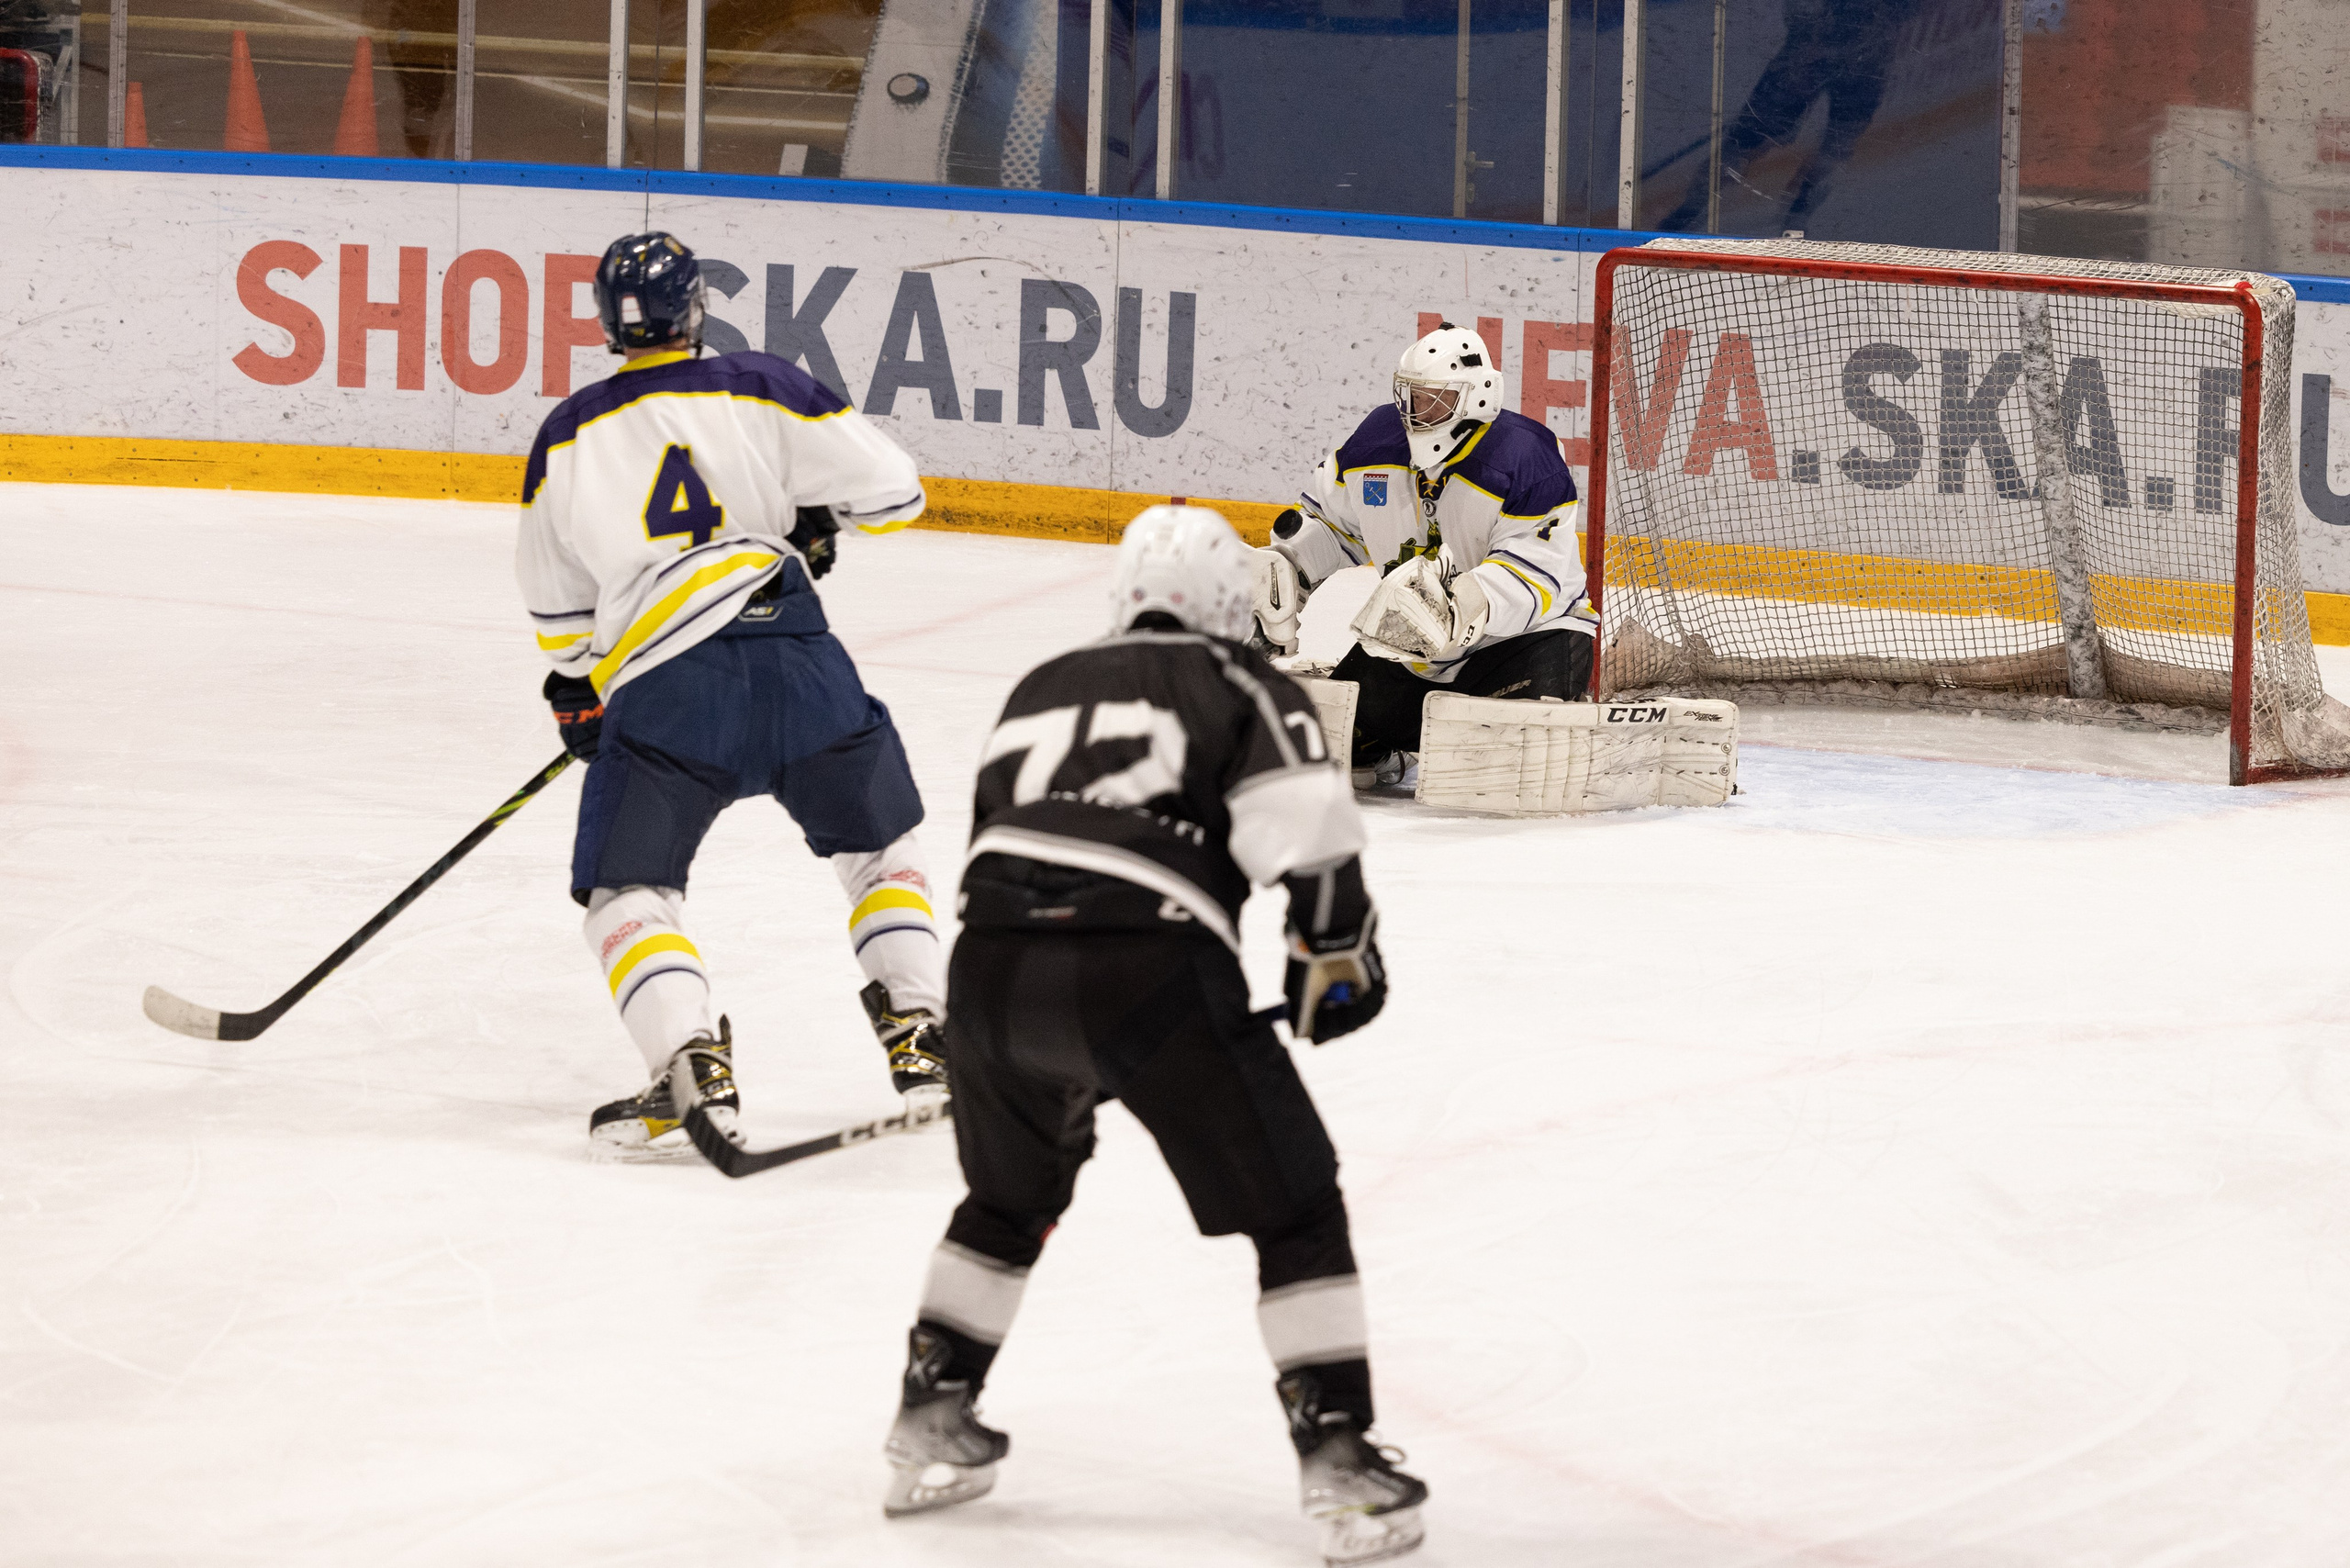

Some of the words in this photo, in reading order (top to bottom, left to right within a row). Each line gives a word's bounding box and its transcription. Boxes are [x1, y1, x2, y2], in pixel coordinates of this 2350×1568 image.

[231, 240, 1196, 438] SHOPKA.RU
[1417, 312, 2350, 526] EVA.SKA.RU
[641, 442, 726, 553] 4
[1537, 518, 1560, 542] 1
[979, 698, 1189, 809] 72
[1606, 707, 1667, 723] CCM
